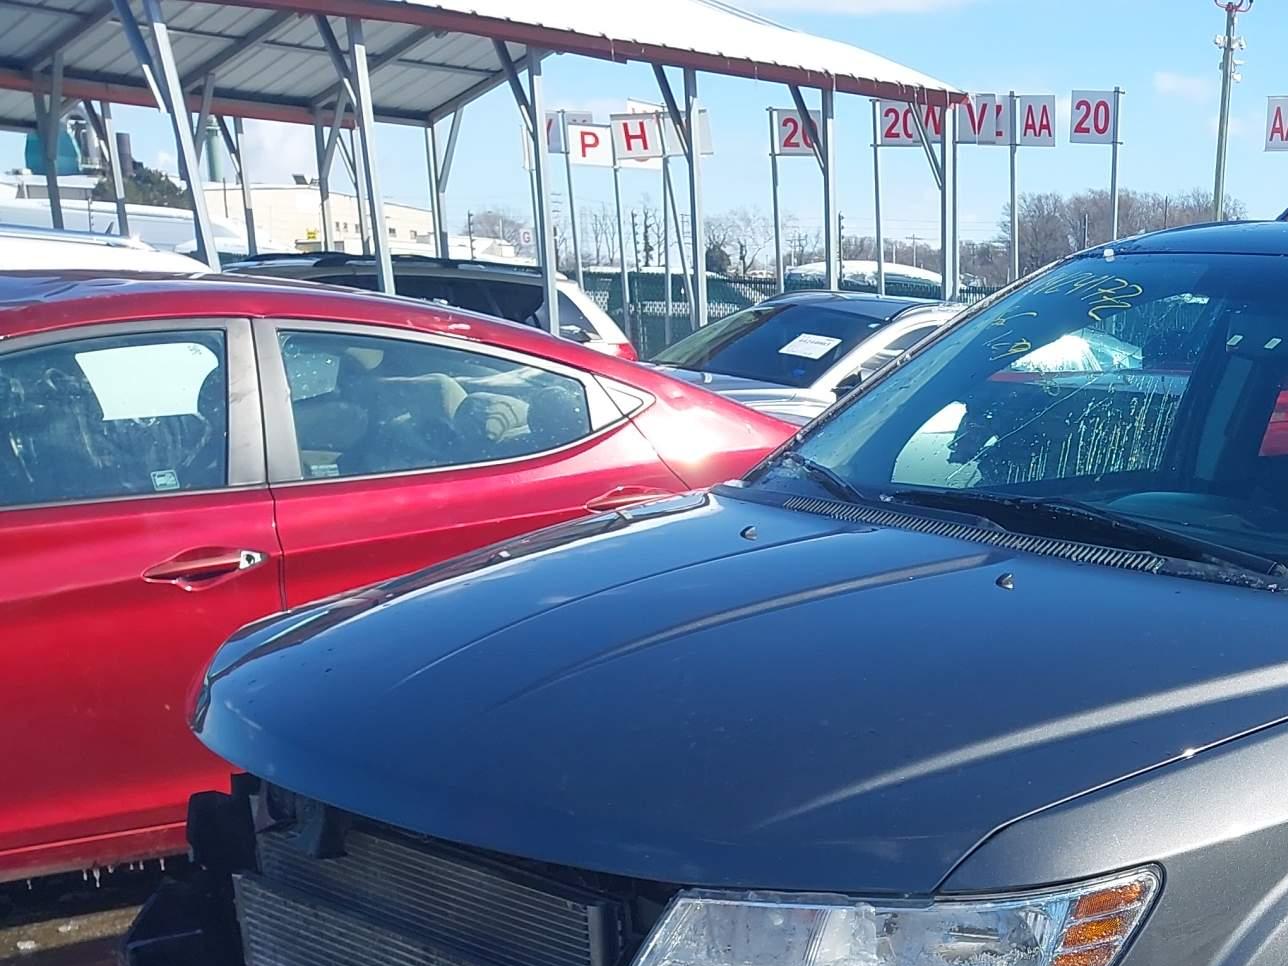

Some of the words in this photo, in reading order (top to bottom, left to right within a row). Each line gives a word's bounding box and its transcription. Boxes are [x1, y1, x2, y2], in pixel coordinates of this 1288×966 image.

[966, 104, 987, 135] V
[1023, 105, 1052, 137] AA
[1074, 100, 1110, 134] 20
[580, 131, 600, 157] P
[623, 121, 649, 151] H
